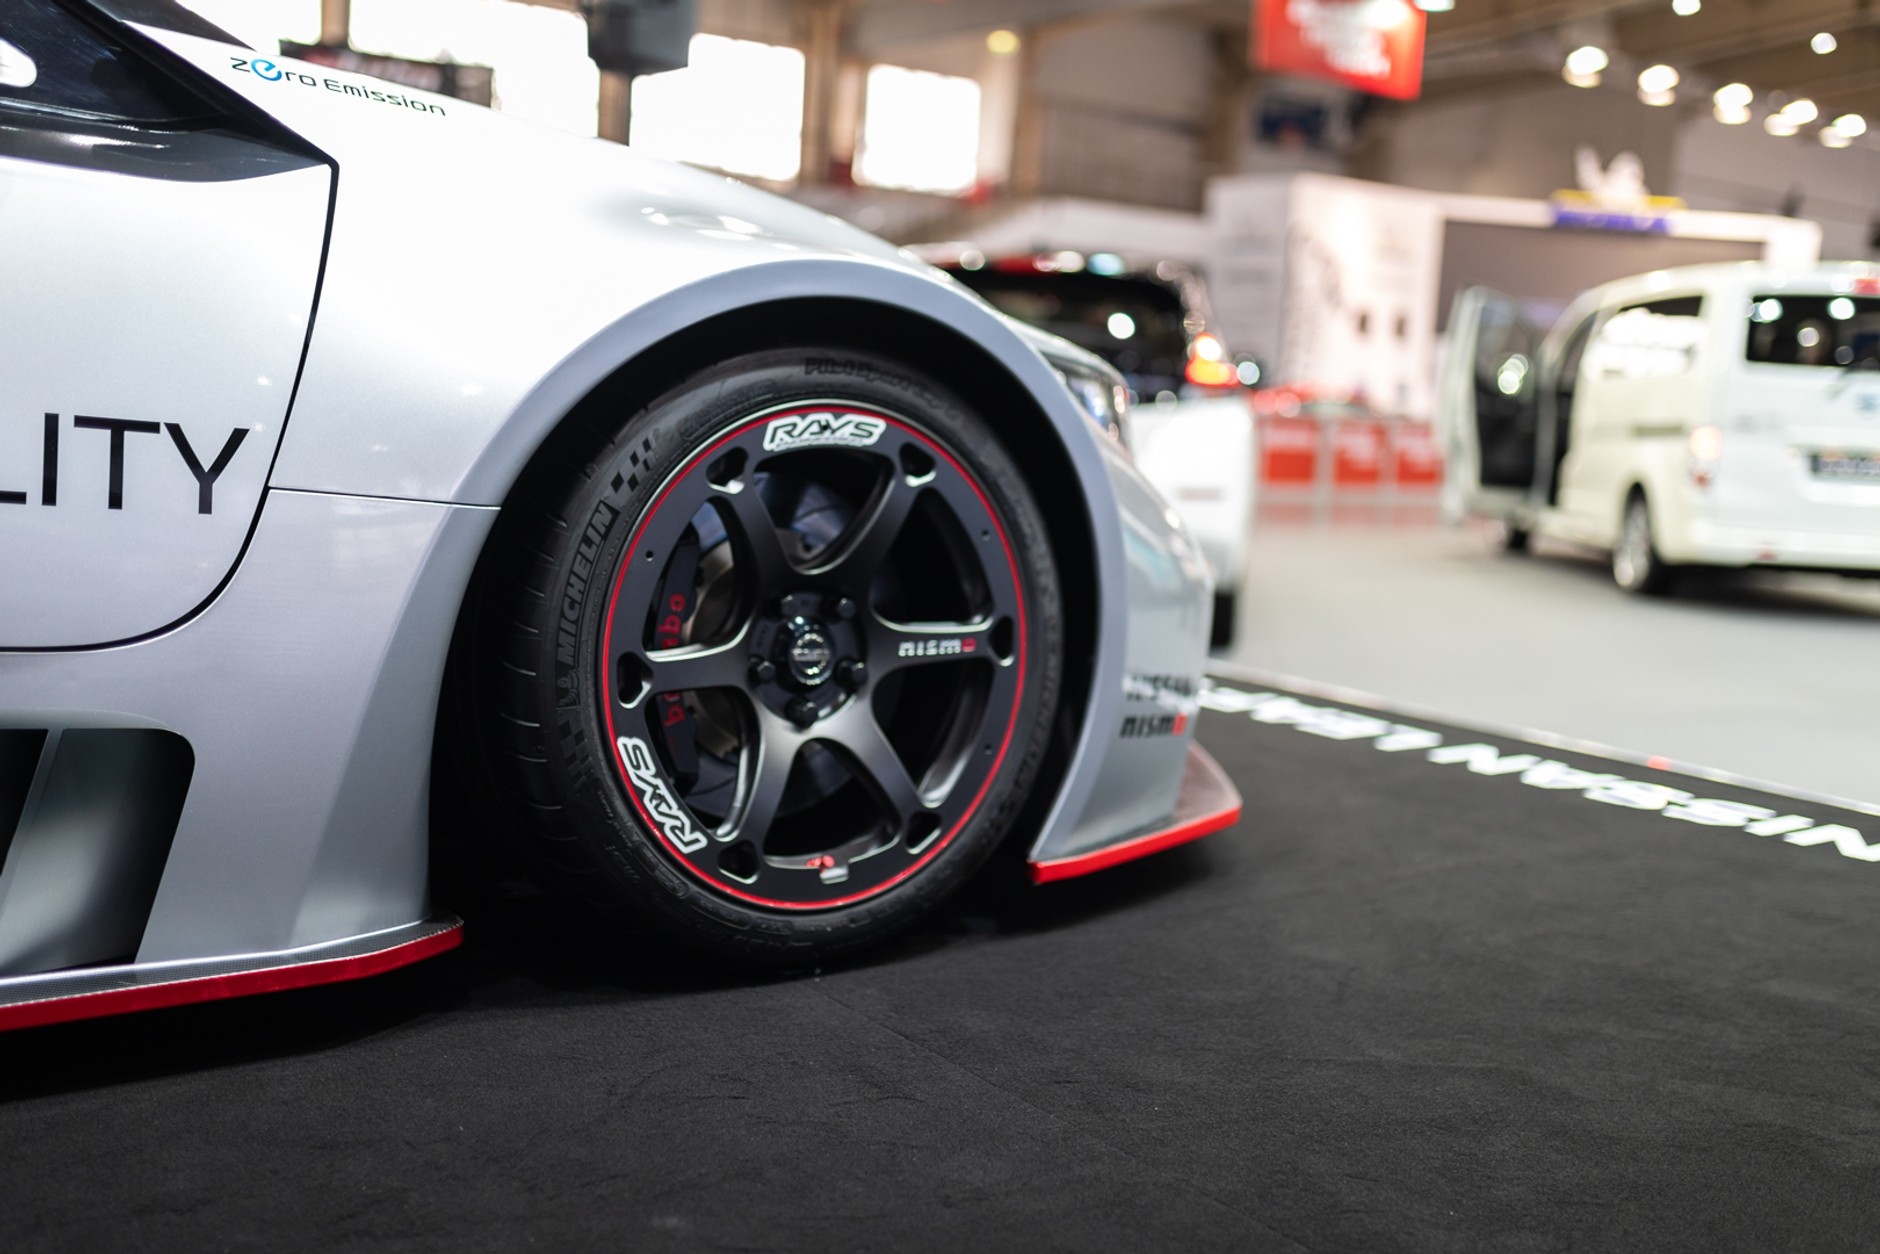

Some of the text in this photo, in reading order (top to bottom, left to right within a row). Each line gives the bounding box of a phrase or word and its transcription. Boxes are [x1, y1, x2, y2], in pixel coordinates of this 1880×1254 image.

[323, 78, 447, 117] Emission
[0, 412, 250, 515] ITY
[766, 414, 885, 446] RAYS
[556, 504, 616, 667] MICHELIN
[618, 737, 707, 852] RAYS
